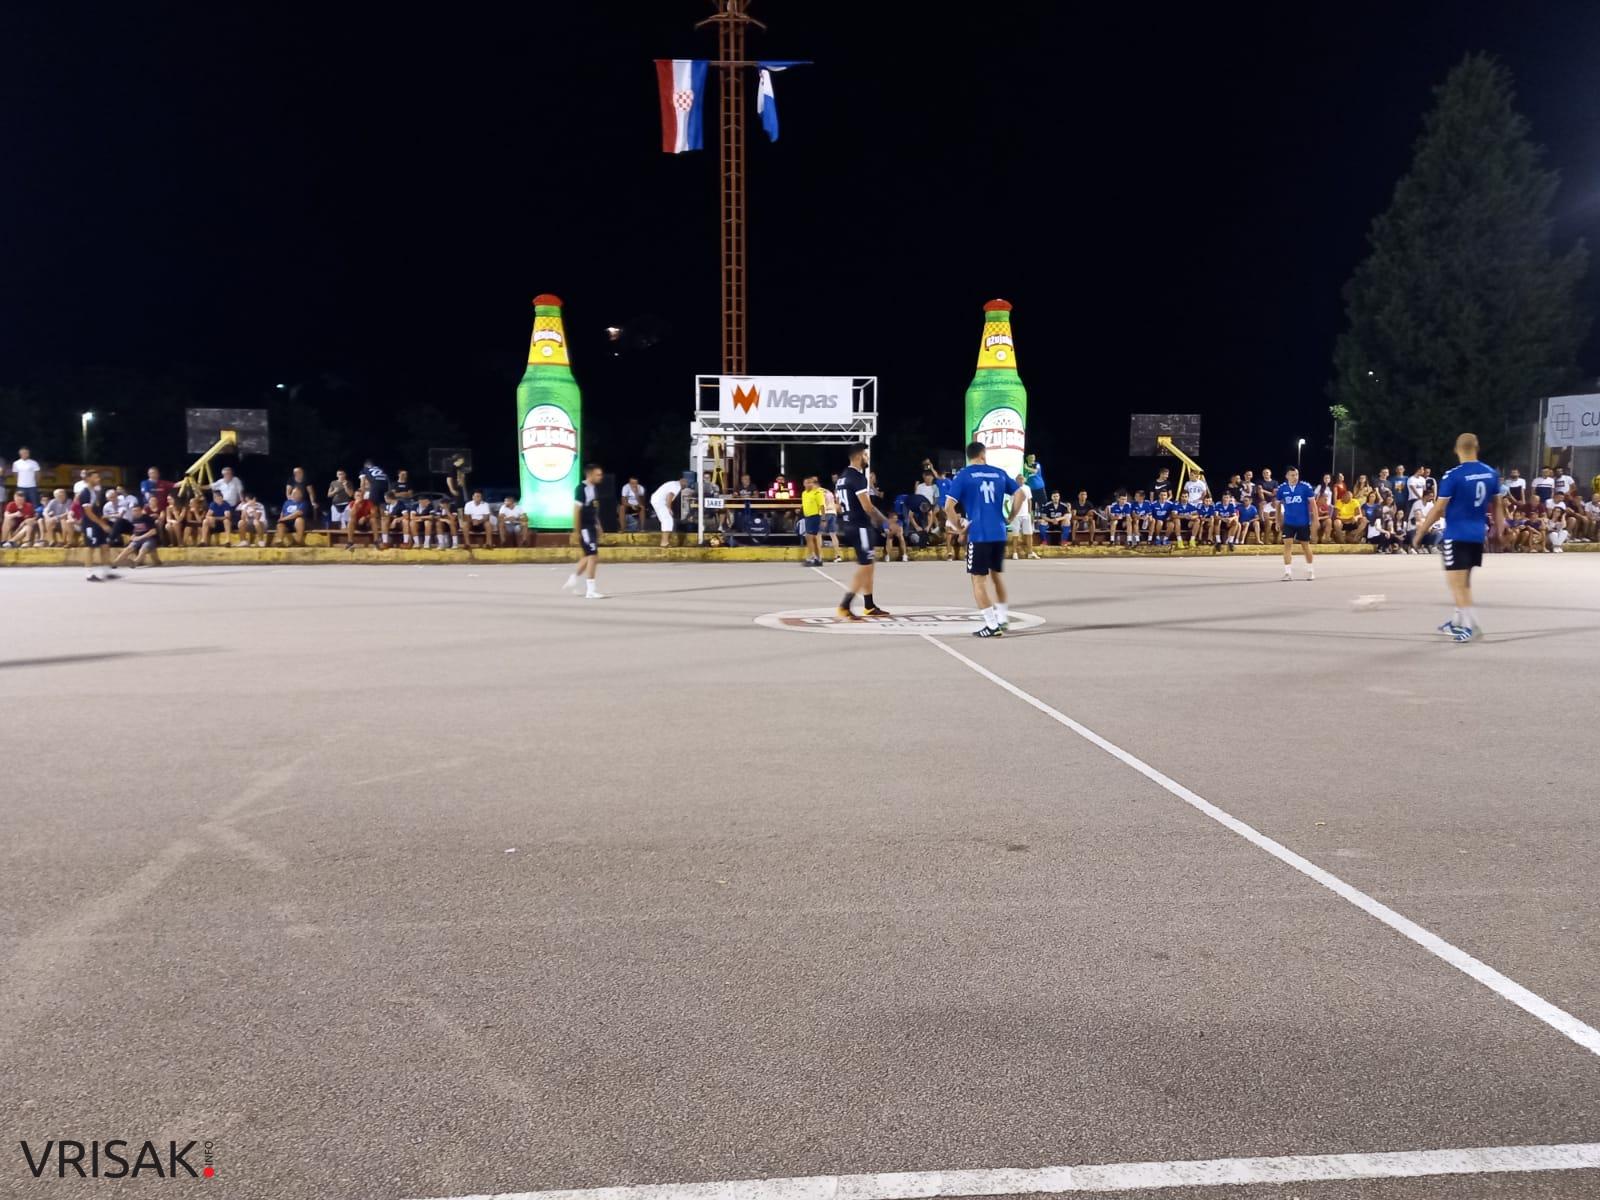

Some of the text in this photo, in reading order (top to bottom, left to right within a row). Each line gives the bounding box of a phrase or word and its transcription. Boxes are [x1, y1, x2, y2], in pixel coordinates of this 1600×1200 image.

[766, 389, 838, 414] Mepas
[980, 480, 995, 504] 11
[1474, 481, 1487, 508] 9
